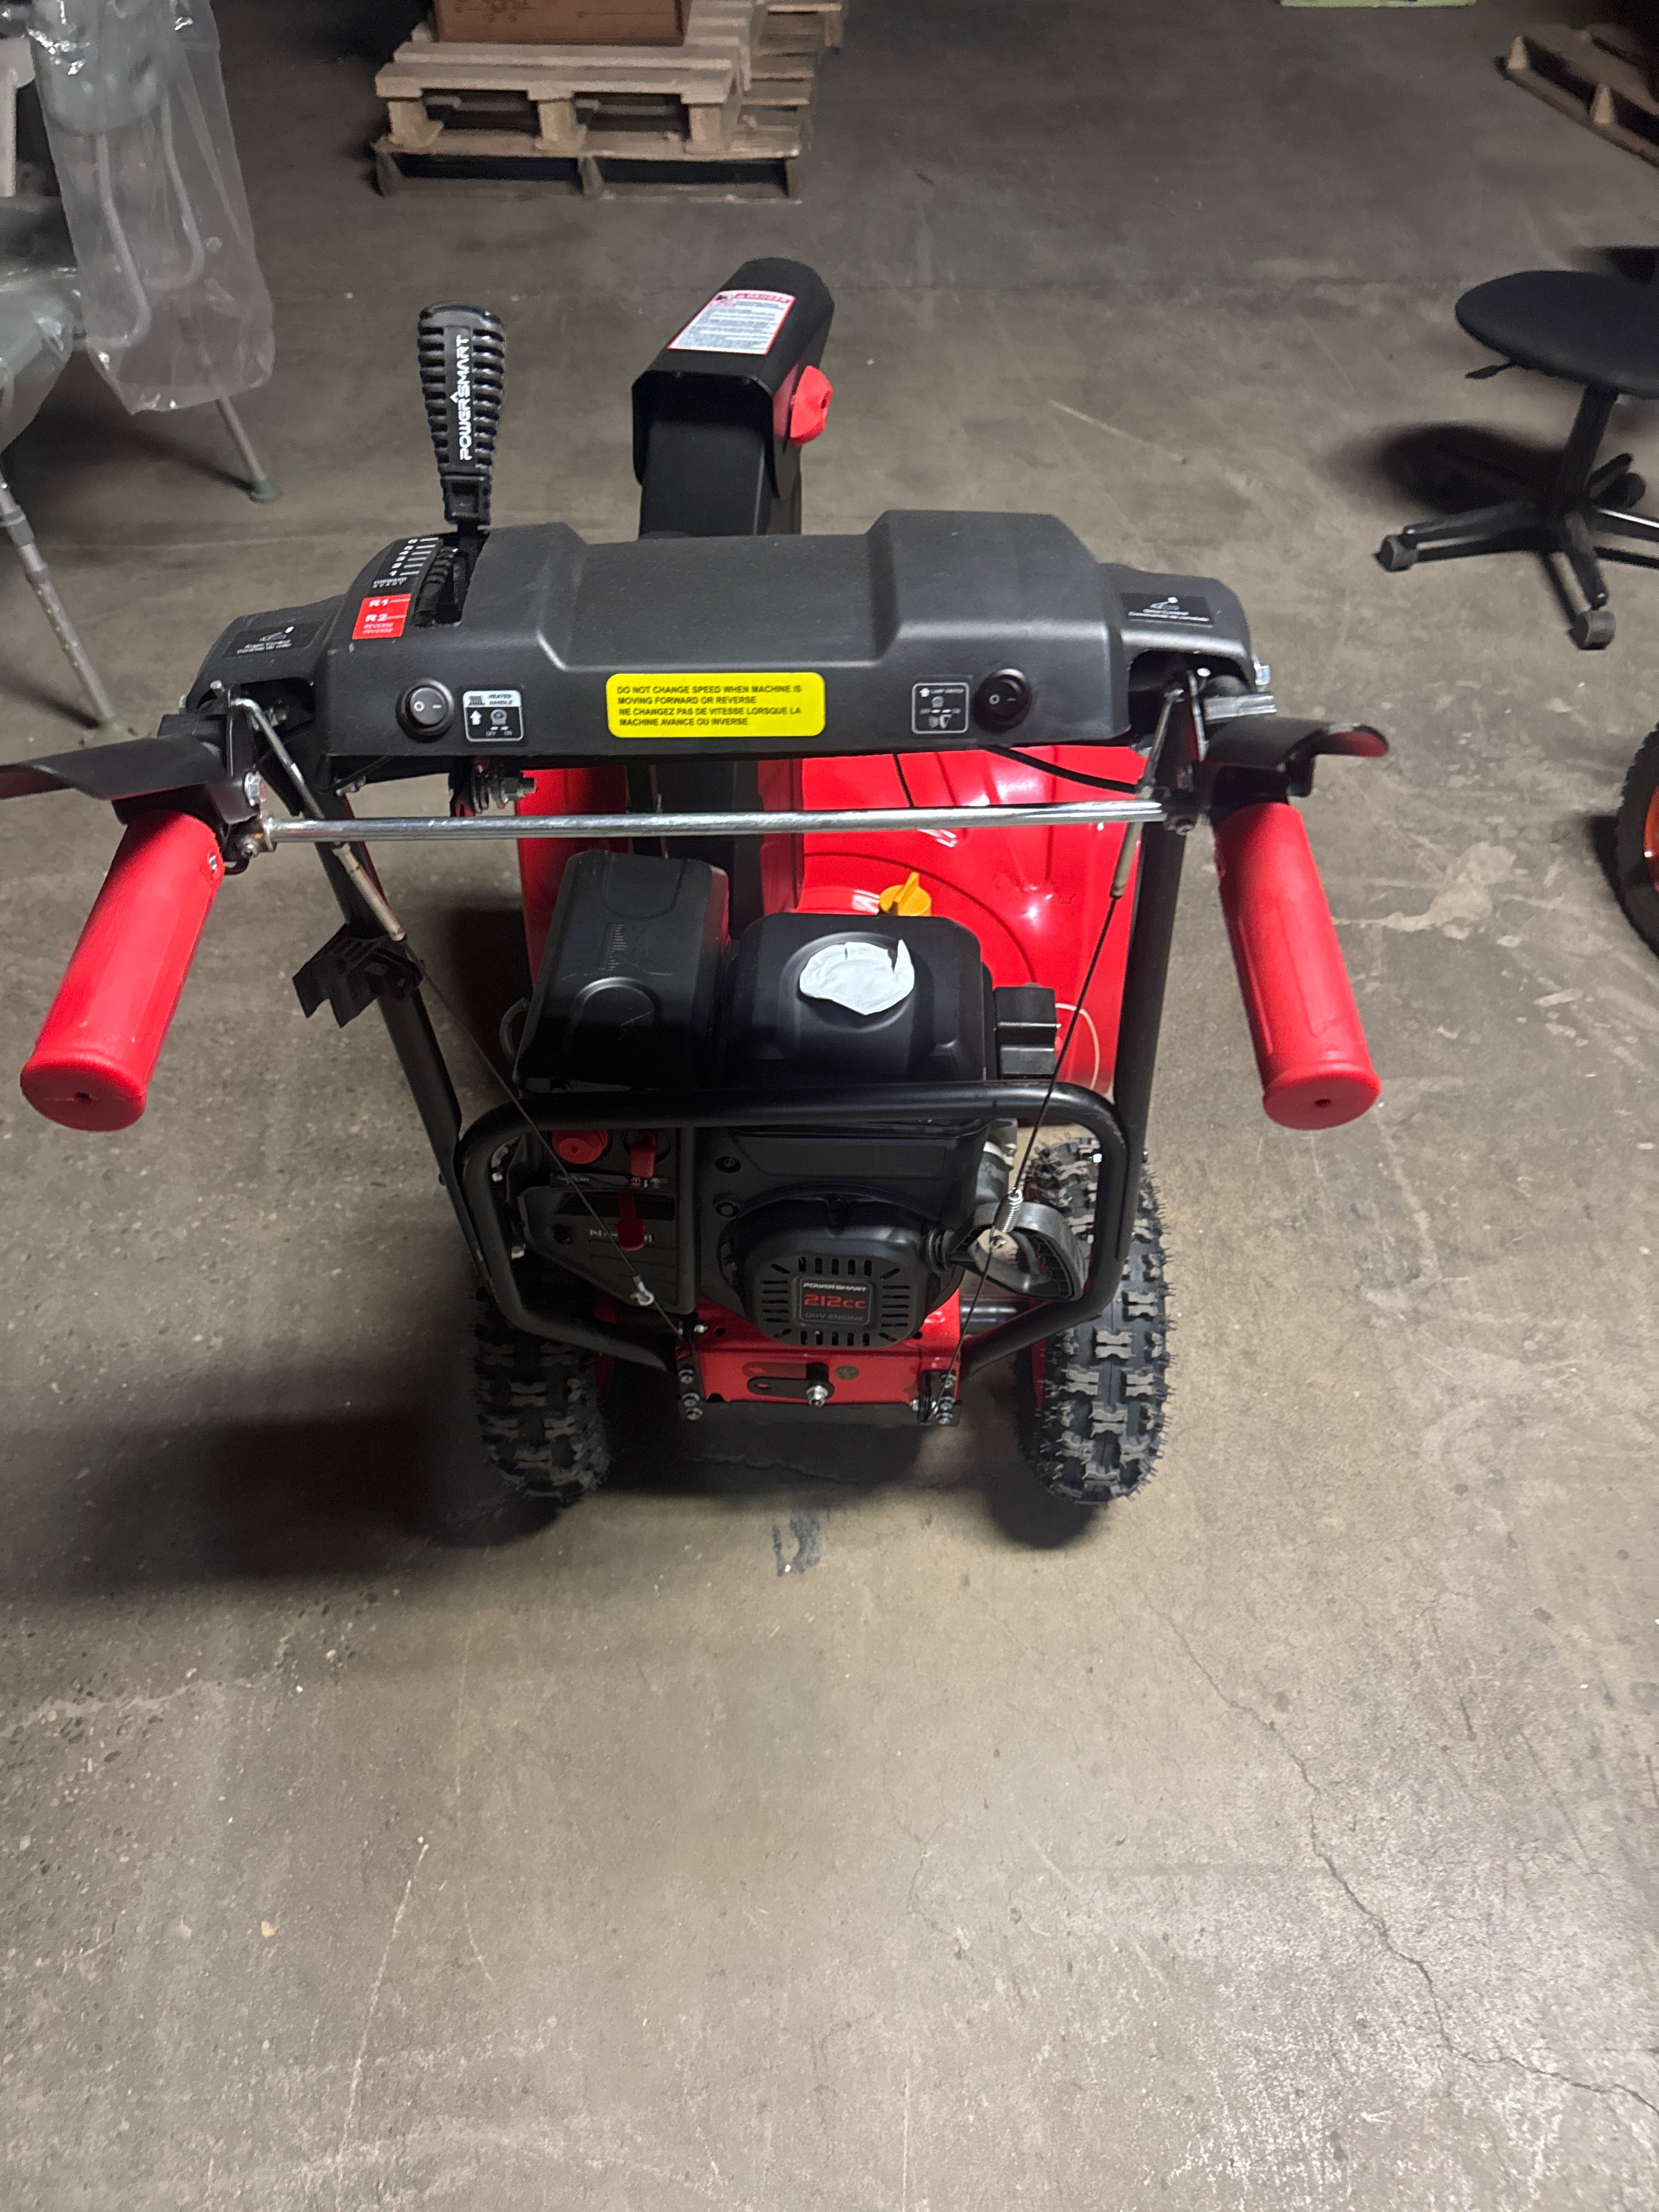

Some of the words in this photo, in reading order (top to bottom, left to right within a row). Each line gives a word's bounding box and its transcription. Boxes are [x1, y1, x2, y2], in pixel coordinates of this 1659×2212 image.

[456, 334, 473, 461] POWERSMART
[369, 599, 388, 608] R1
[365, 613, 388, 622] R2
[803, 1282, 867, 1292] POWERSMART
[804, 1294, 867, 1310] 212cc
